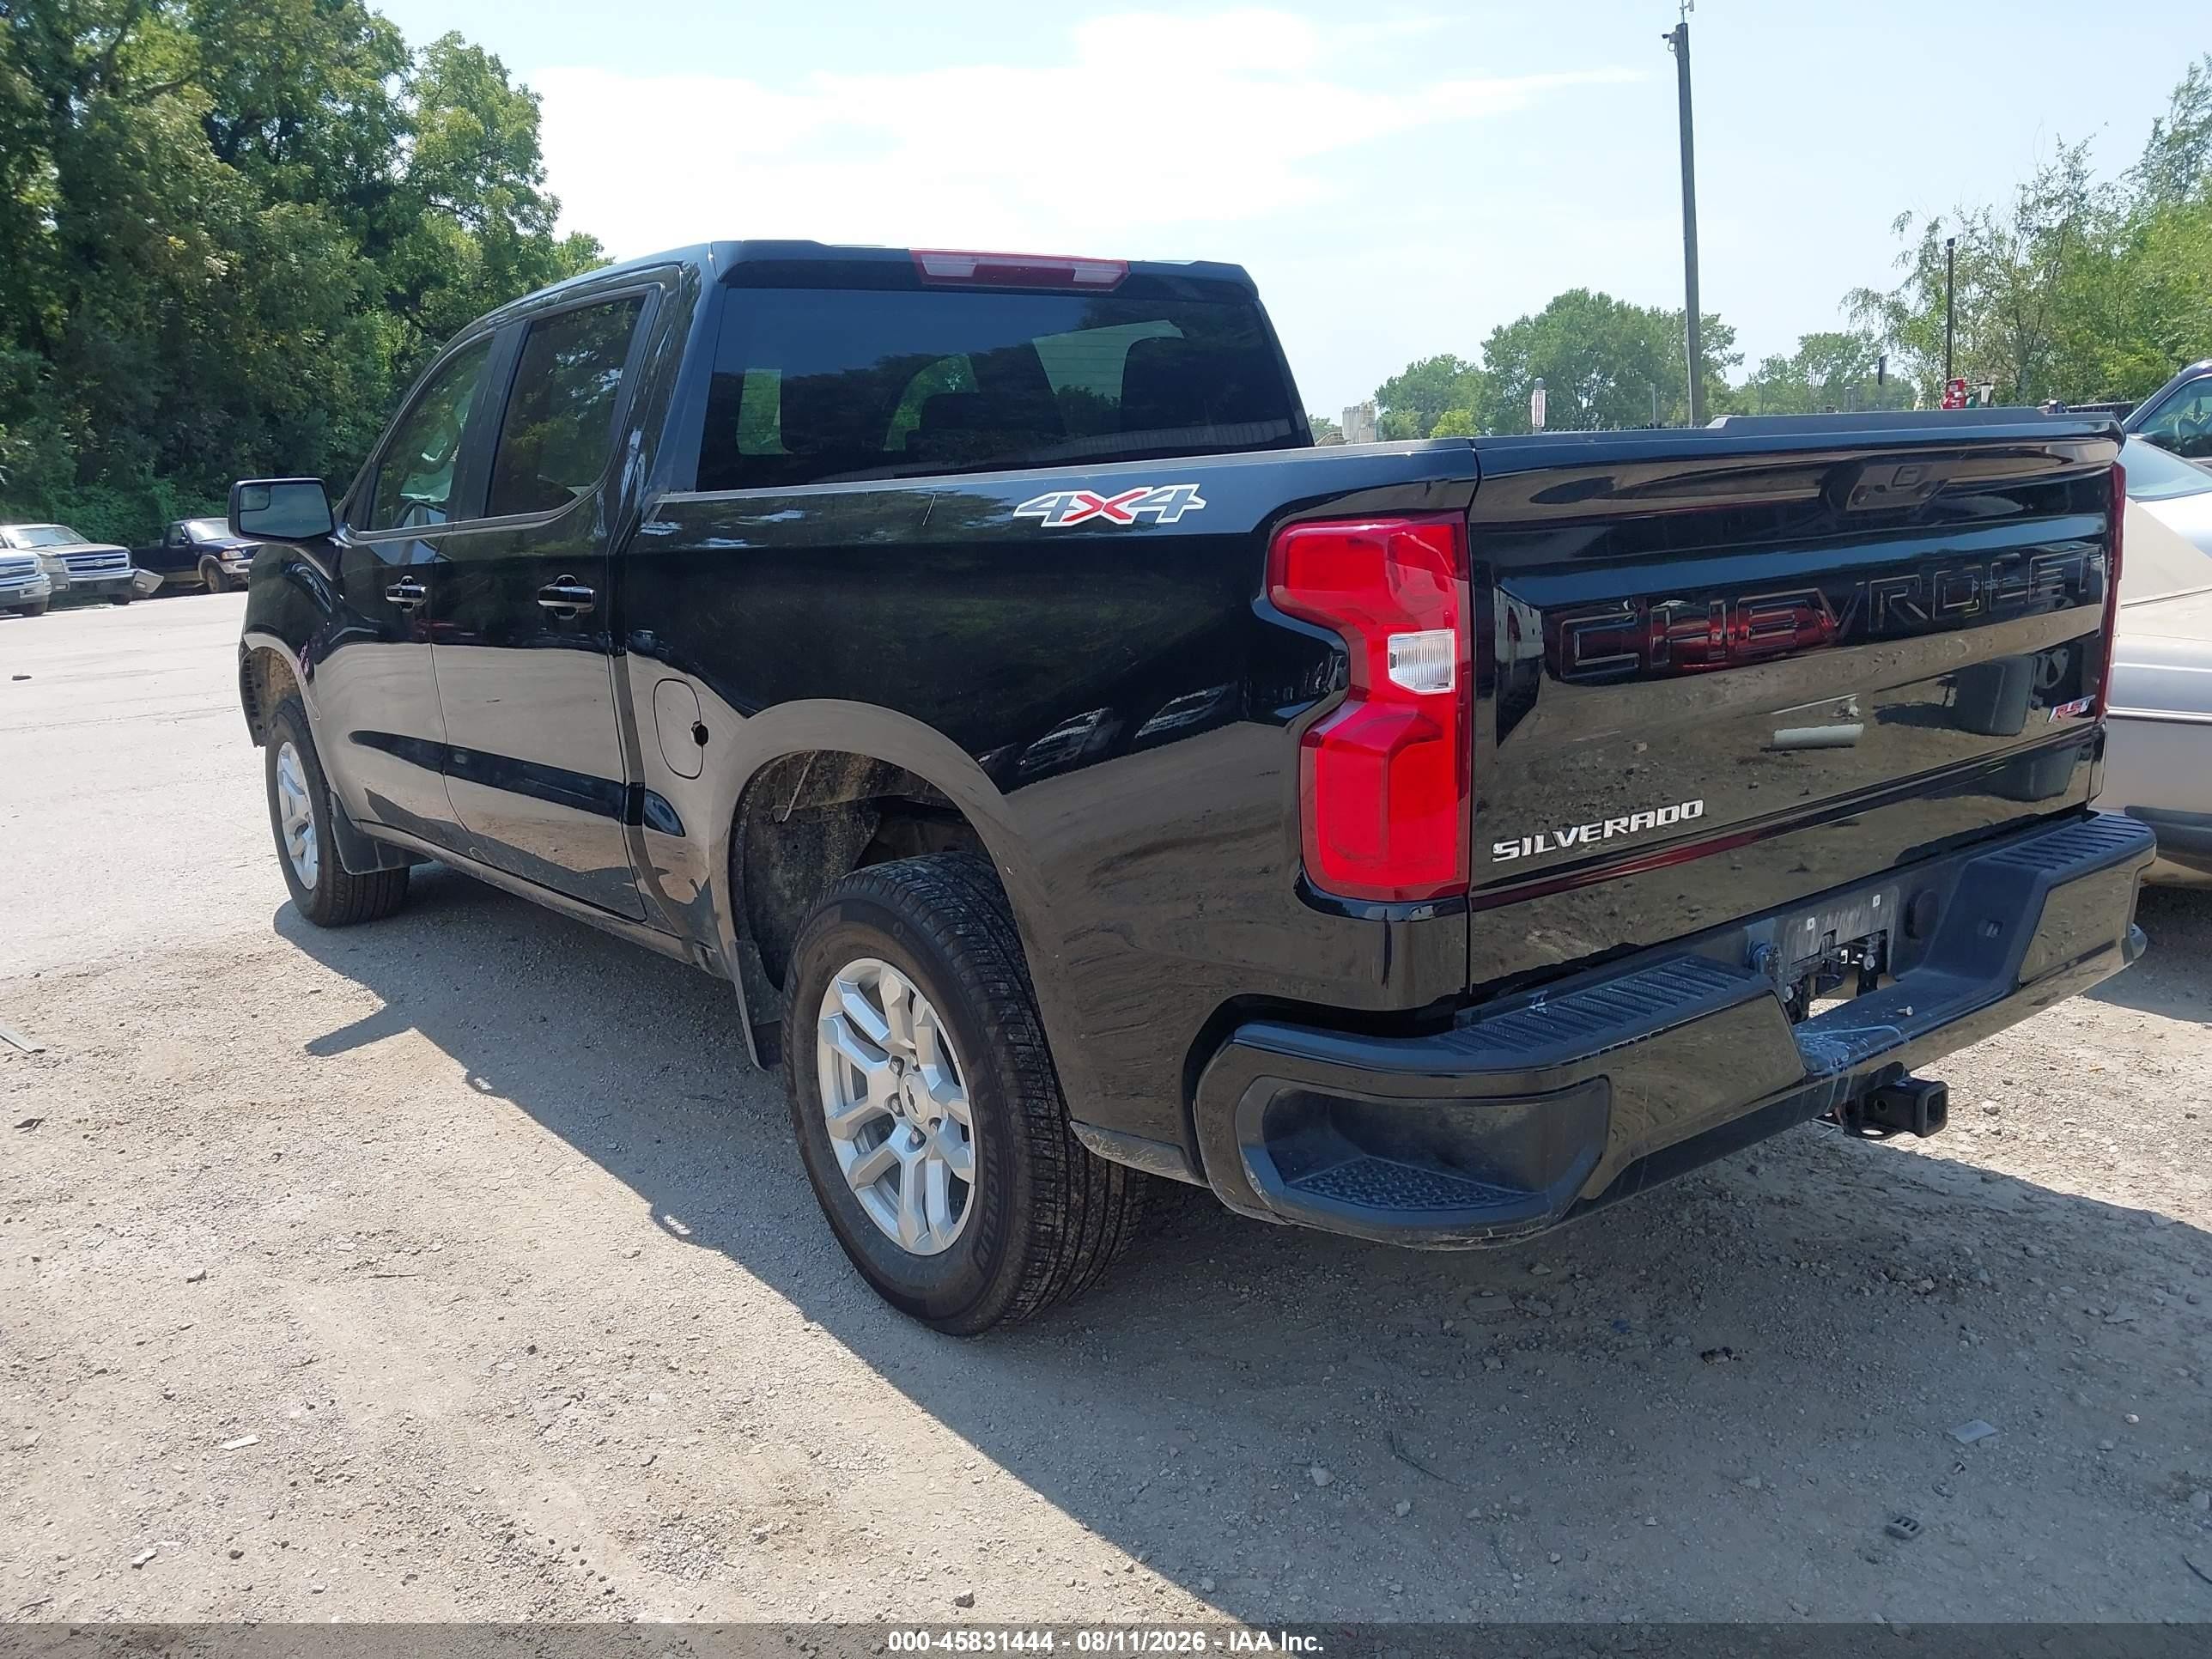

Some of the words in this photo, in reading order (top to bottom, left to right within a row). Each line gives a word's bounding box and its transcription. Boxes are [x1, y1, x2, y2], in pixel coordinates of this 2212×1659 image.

[1559, 544, 2103, 680] CHEVROLET
[2047, 694, 2096, 723] RST
[1492, 799, 1704, 863] SILVERADO
